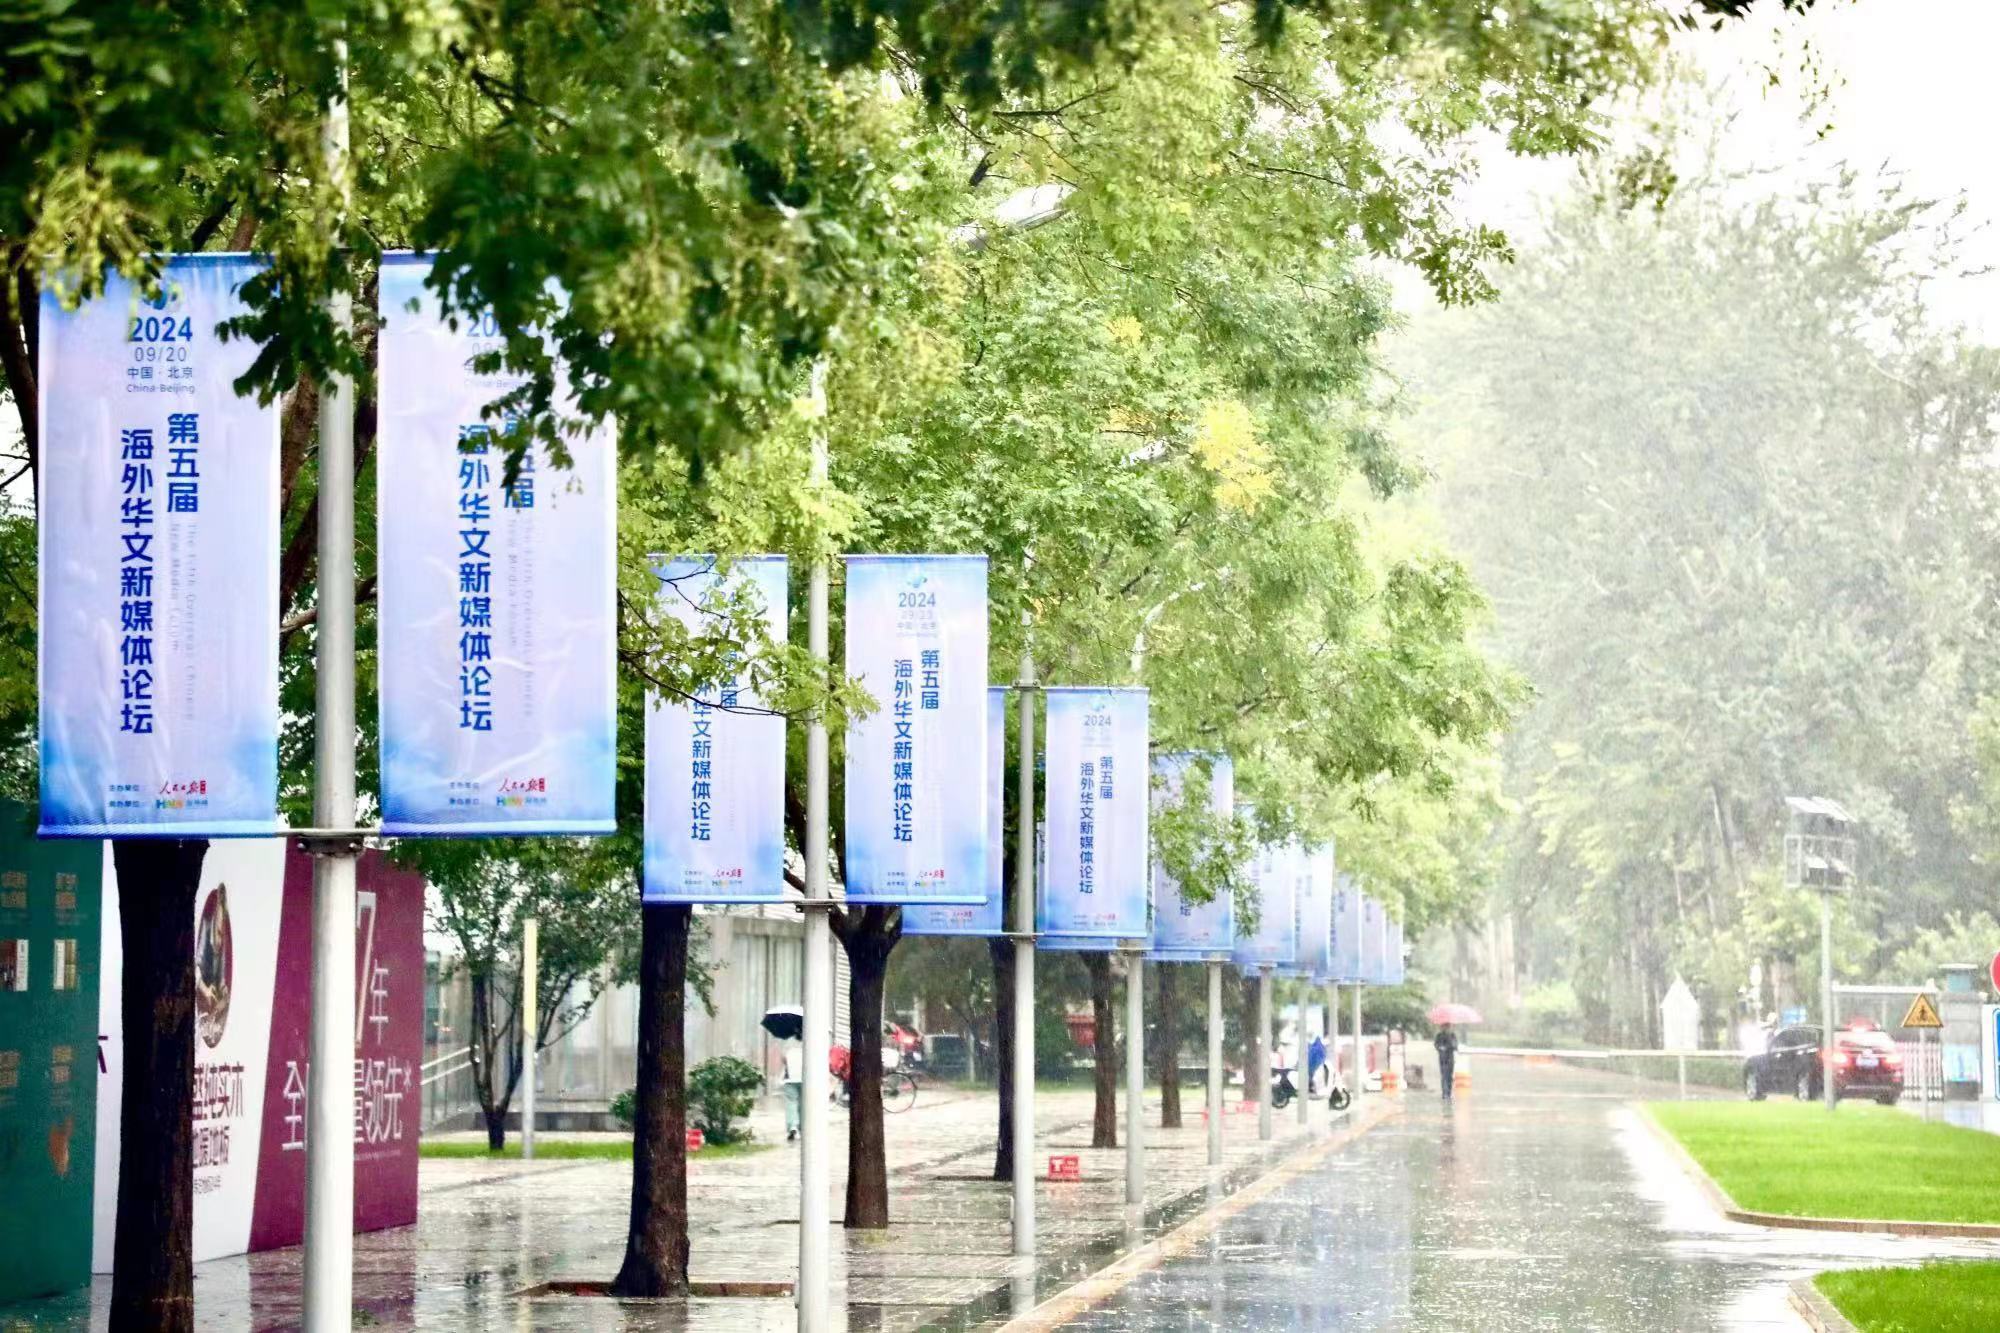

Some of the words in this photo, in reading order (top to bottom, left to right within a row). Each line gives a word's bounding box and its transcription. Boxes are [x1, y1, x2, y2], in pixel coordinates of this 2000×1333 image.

[128, 316, 193, 342] 2024
[135, 346, 187, 362] 09/20
[166, 412, 200, 513] 第五届
[120, 428, 154, 734] 海外华文新媒体论坛
[898, 592, 936, 608] 2024
[920, 650, 939, 709] 第五届
[893, 659, 912, 842] 海外华文新媒体论坛
[1100, 757, 1113, 799] 第五届
[1079, 762, 1094, 894] 海外华文新媒体论坛
